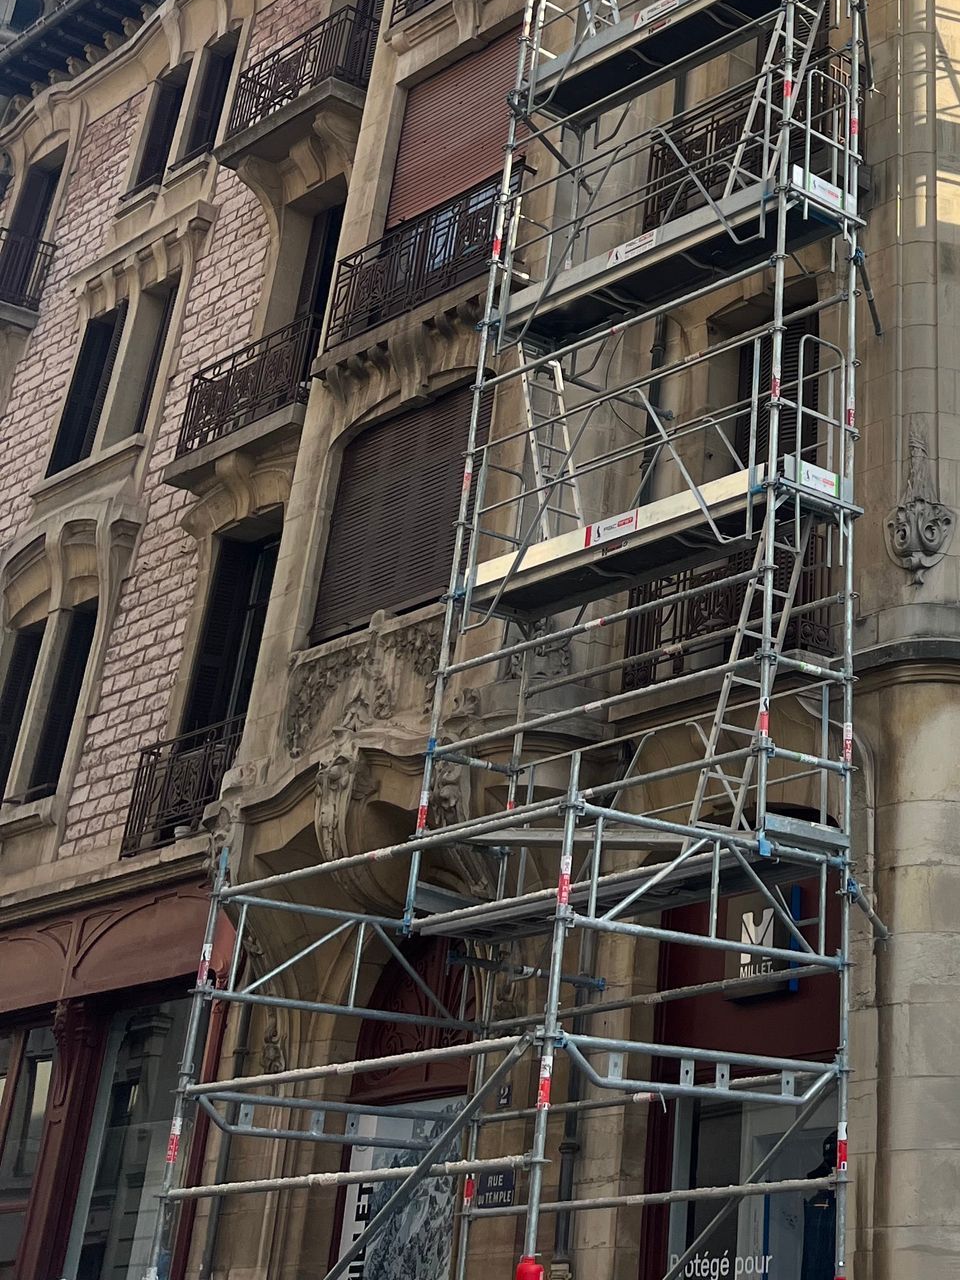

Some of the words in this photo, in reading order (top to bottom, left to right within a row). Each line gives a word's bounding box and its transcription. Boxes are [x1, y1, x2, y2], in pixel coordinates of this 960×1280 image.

[500, 1087, 509, 1104] 2
[487, 1175, 504, 1187] RUE
[485, 1190, 511, 1204] TEMPLE
[734, 1255, 773, 1280] pour
